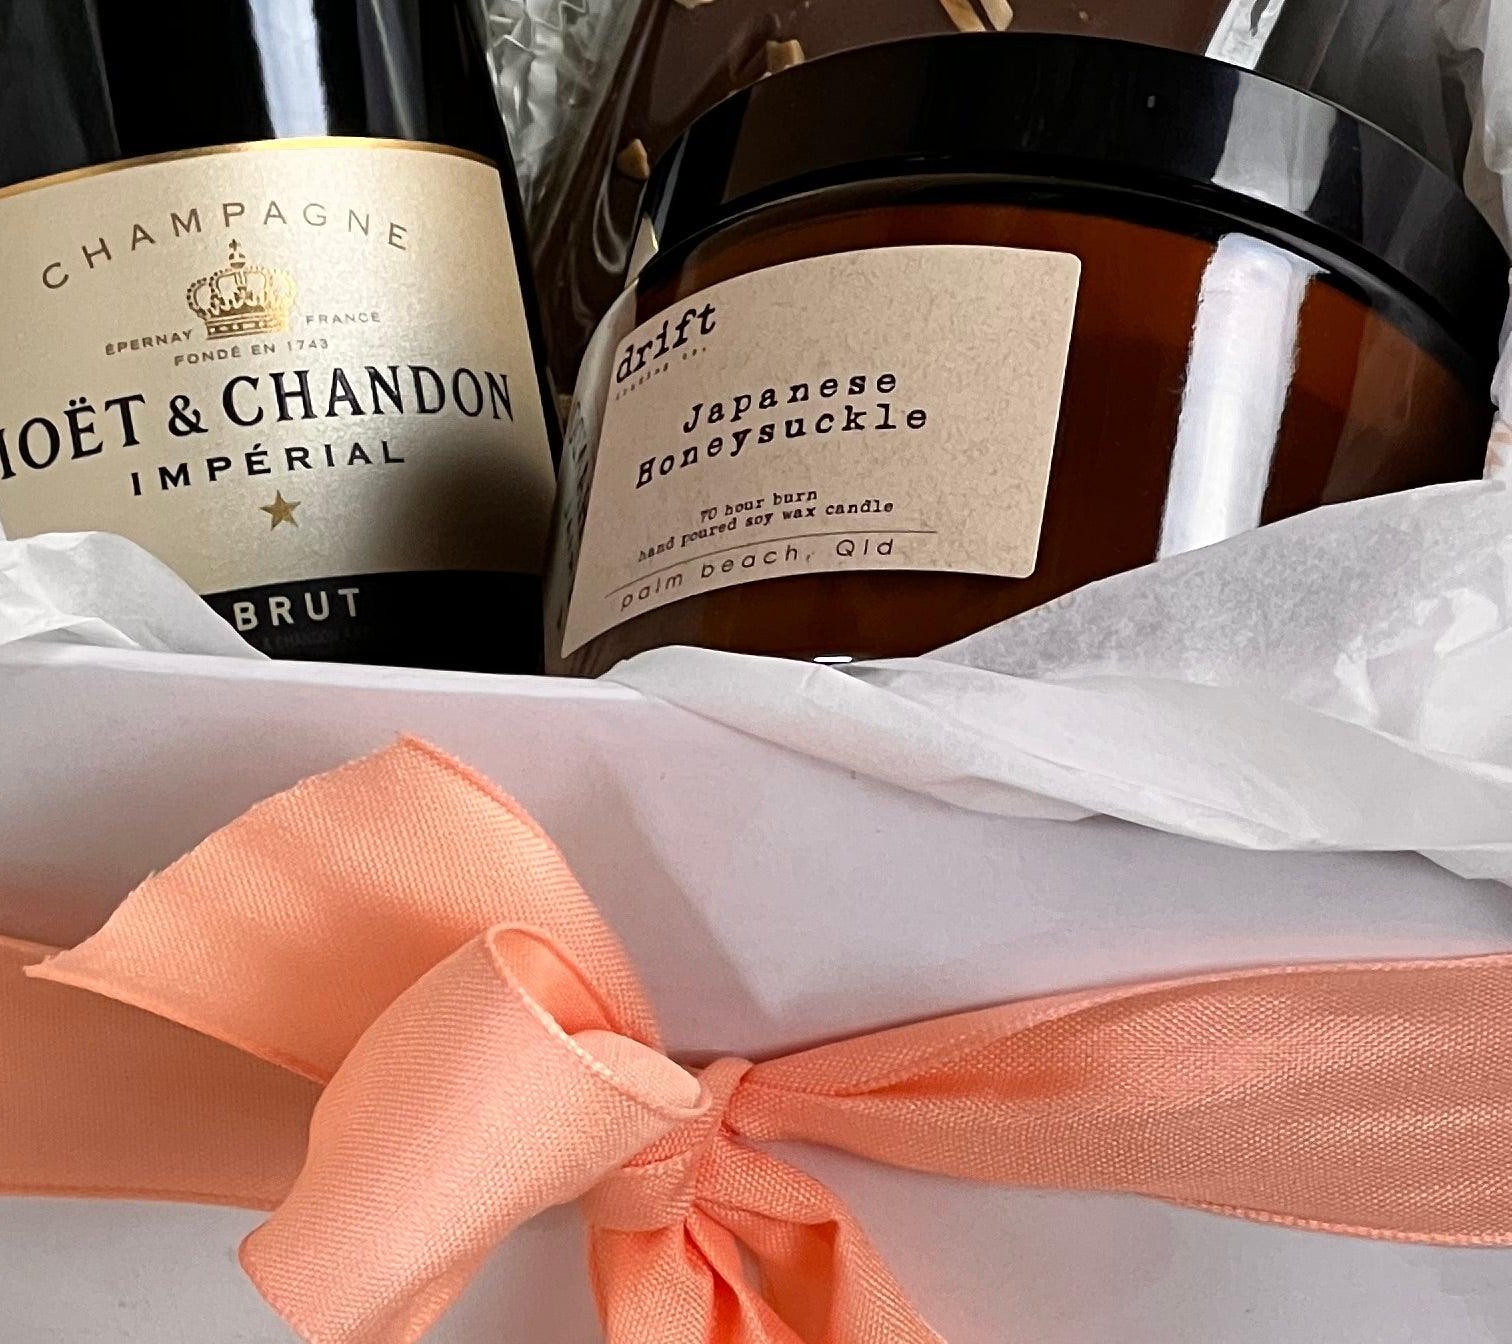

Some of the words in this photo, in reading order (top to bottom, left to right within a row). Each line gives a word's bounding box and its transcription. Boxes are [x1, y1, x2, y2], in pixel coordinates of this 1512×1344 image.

[42, 200, 407, 290] CHAMPAGNE
[105, 328, 193, 356] ÉPERNAY
[305, 311, 382, 326] FRANCE
[174, 346, 240, 366] FONDÉ
[251, 341, 276, 356] EN
[287, 338, 329, 352] 1743
[616, 303, 716, 384] drift
[167, 394, 209, 438] &
[221, 365, 516, 427] CHANDON
[683, 373, 896, 433] Japanese
[130, 440, 405, 496] IMPÉRIAL
[636, 403, 927, 489] Honeysuckle
[638, 537, 674, 562] hand
[681, 517, 737, 547] poured
[745, 511, 773, 528] soy
[782, 506, 816, 521] wax
[825, 499, 894, 515] candle
[700, 508, 718, 523] 70
[725, 498, 765, 516] hour
[773, 490, 818, 507] burn
[620, 573, 683, 612] palm
[701, 545, 811, 578] beach,
[836, 538, 894, 557] Qld
[232, 587, 360, 632] BRUT
